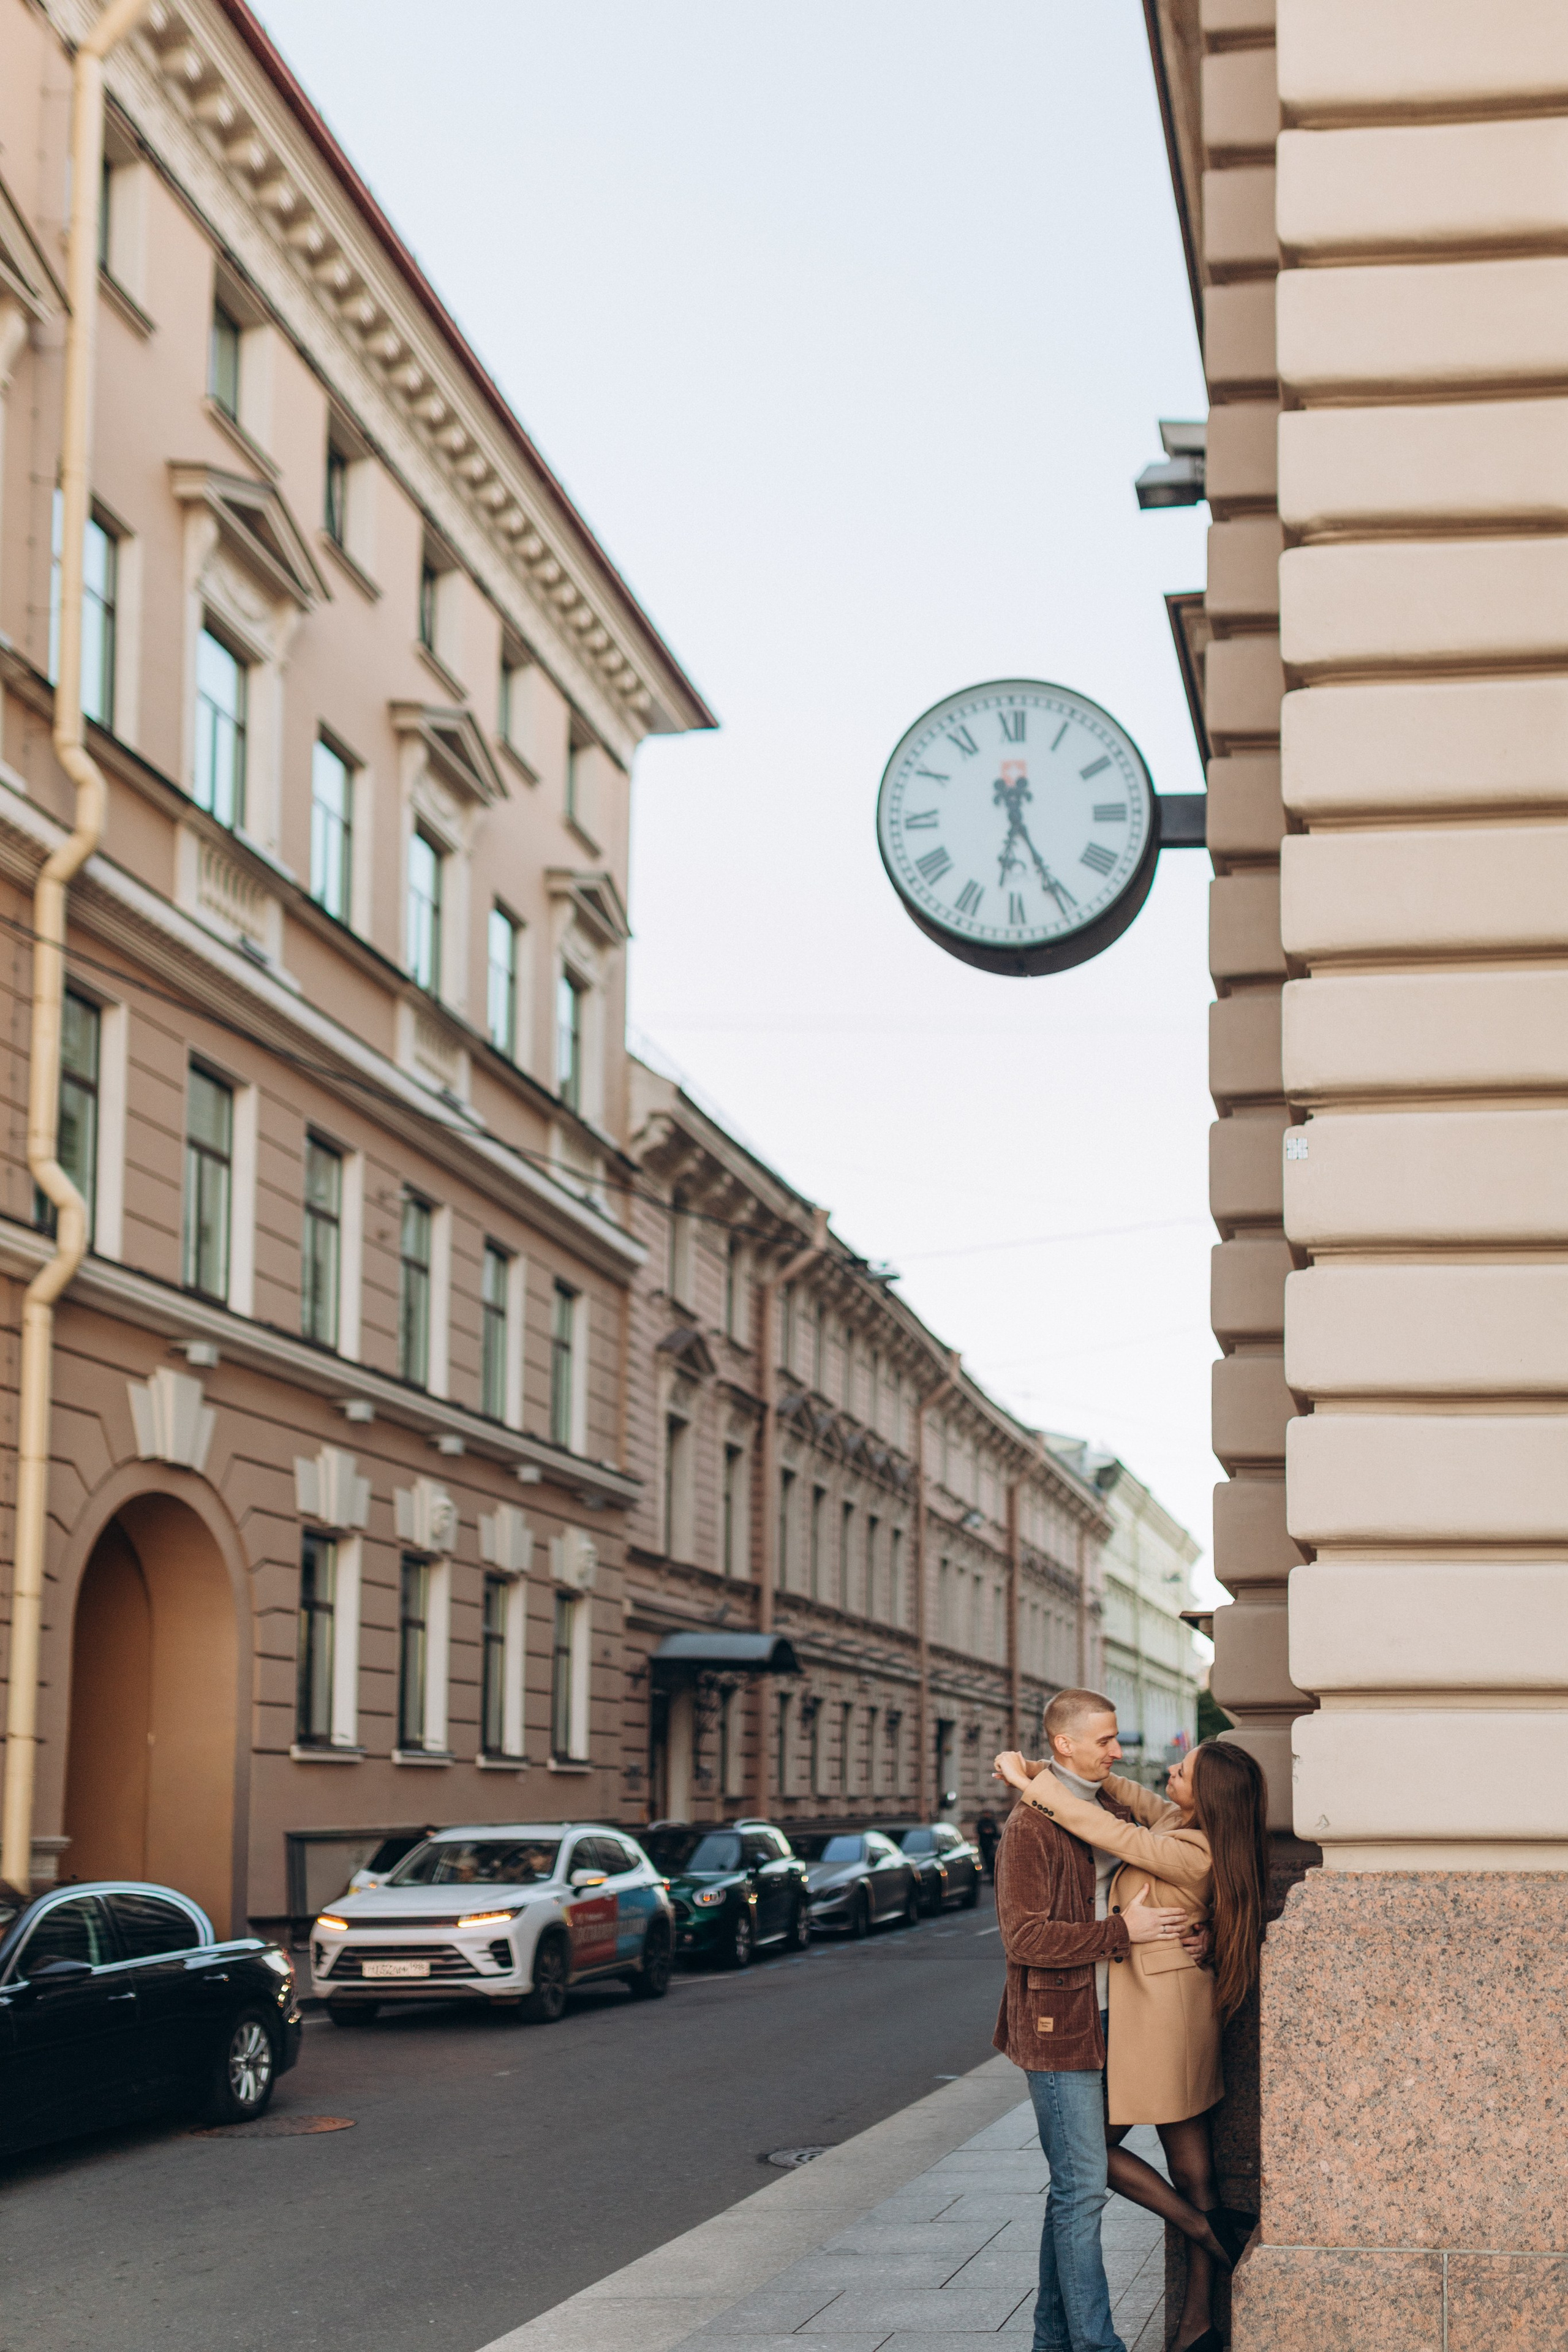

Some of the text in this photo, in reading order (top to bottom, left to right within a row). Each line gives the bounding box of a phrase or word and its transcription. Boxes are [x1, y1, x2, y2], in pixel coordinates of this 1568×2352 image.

[997, 710, 1025, 742] XII
[1051, 721, 1069, 752] I
[946, 725, 978, 759] XI
[916, 763, 951, 787] X
[1080, 755, 1112, 780] II
[905, 808, 939, 829] IX
[1093, 802, 1127, 822] III
[914, 846, 954, 886] VIII
[954, 878, 985, 917] VII
[1008, 891, 1027, 925] VI
